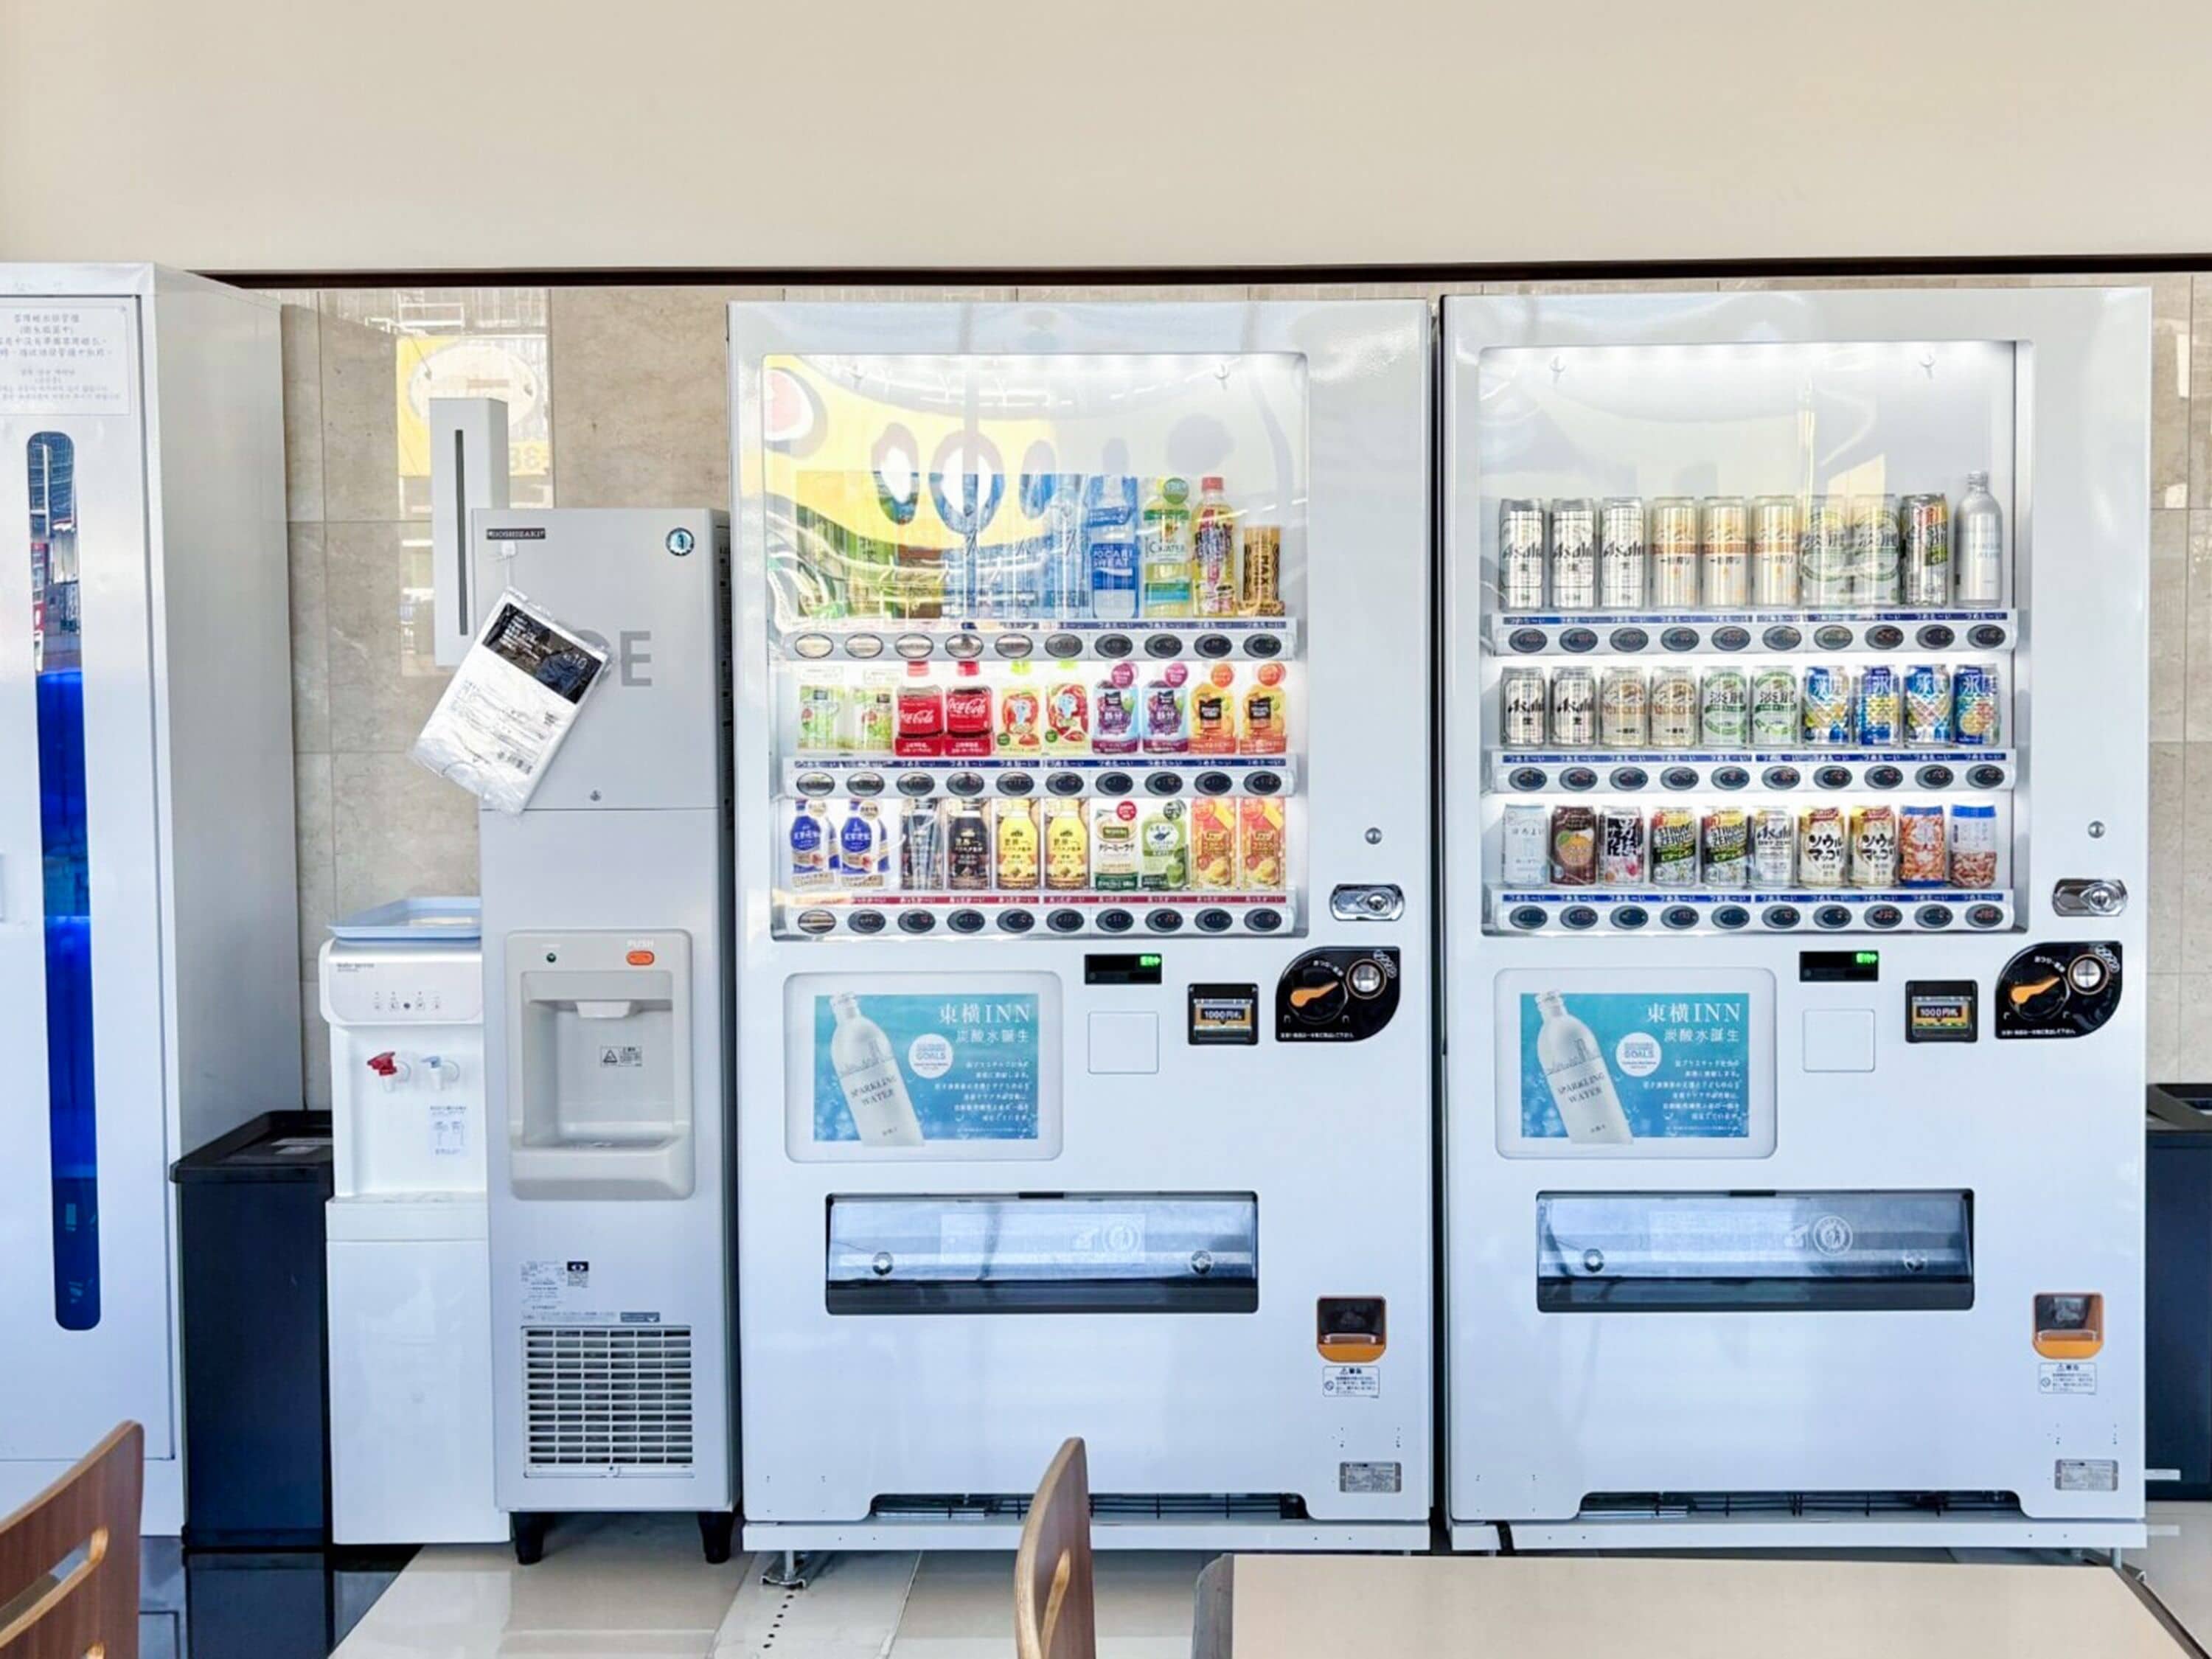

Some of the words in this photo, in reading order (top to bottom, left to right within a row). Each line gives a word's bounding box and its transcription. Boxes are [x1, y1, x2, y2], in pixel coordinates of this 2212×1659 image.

[627, 939, 654, 948] PUSH
[939, 1003, 1031, 1024] 東横INN
[1646, 1003, 1741, 1023] 東横INN
[861, 1088, 895, 1106] WATER
[1568, 1086, 1603, 1104] WATER
